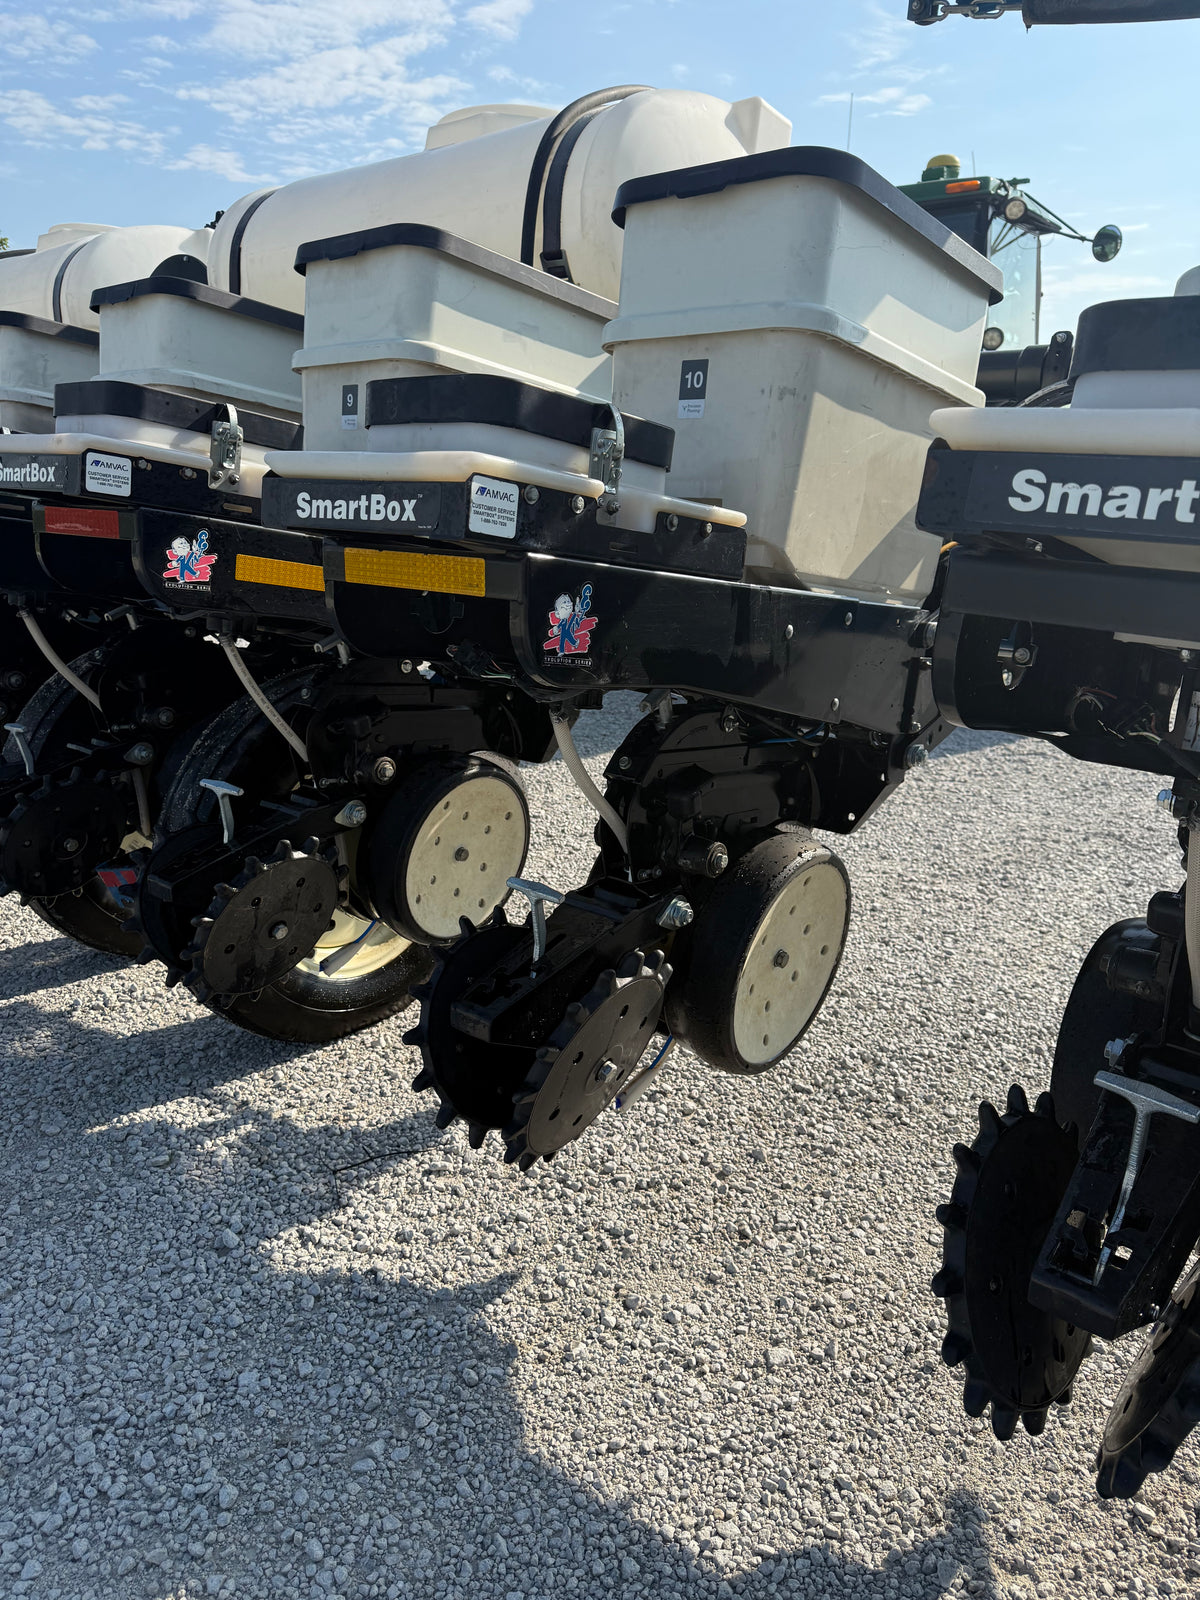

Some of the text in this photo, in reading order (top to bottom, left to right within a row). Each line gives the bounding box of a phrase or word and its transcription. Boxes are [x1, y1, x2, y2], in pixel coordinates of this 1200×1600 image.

[684, 370, 704, 389] 10
[346, 393, 354, 407] 9
[99, 461, 129, 471] AMVAC
[88, 470, 112, 478] CUSTOMER
[485, 488, 515, 503] AMVAC
[1007, 468, 1200, 524] Smart
[471, 502, 516, 517] CUSTOMER SERVICE
[497, 514, 515, 523] SYSTEMS
